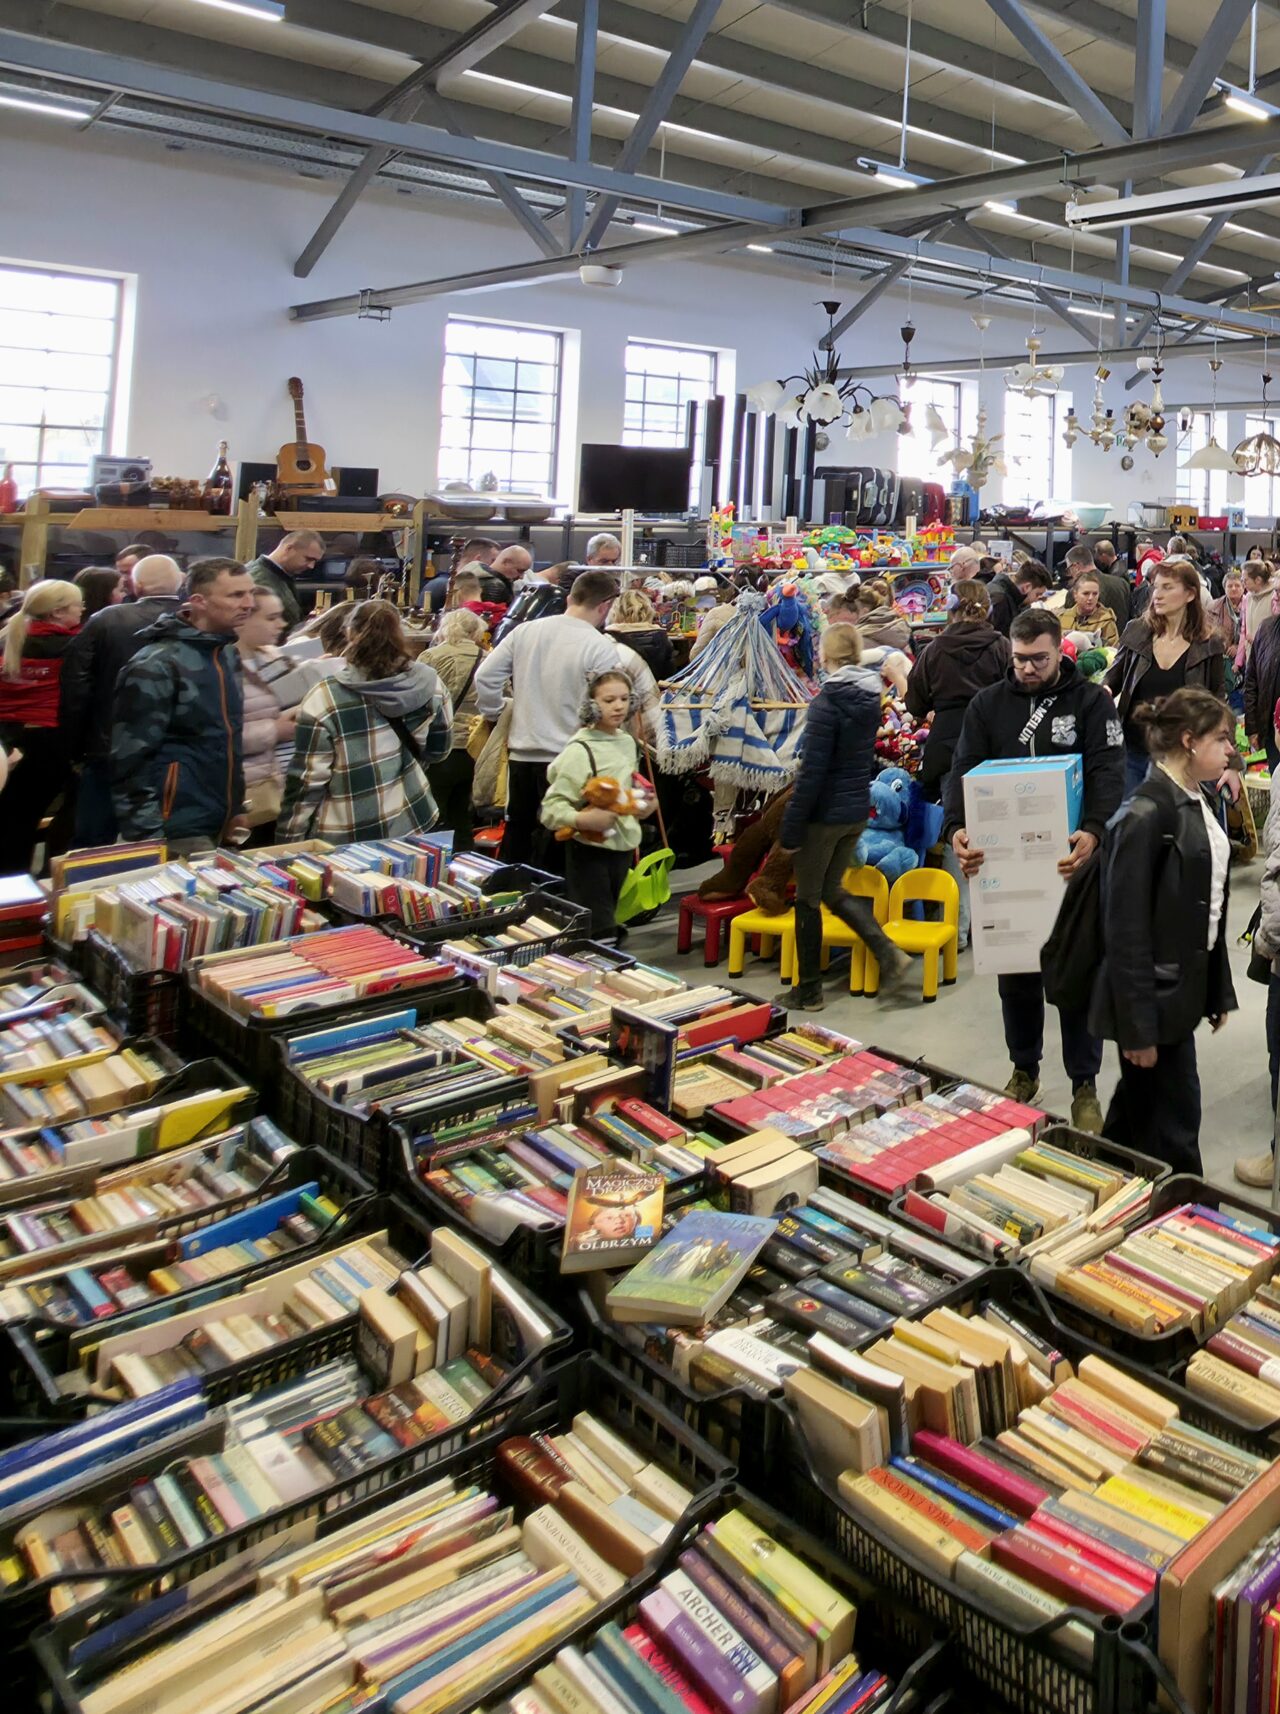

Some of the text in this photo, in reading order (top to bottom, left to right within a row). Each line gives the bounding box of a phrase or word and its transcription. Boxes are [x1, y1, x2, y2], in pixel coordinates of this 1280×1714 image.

[585, 1177, 662, 1191] MAGICZNE
[591, 1184, 656, 1197] DRZEWO
[579, 1237, 652, 1251] OLBRZYM
[678, 1588, 734, 1647] ARCHER
